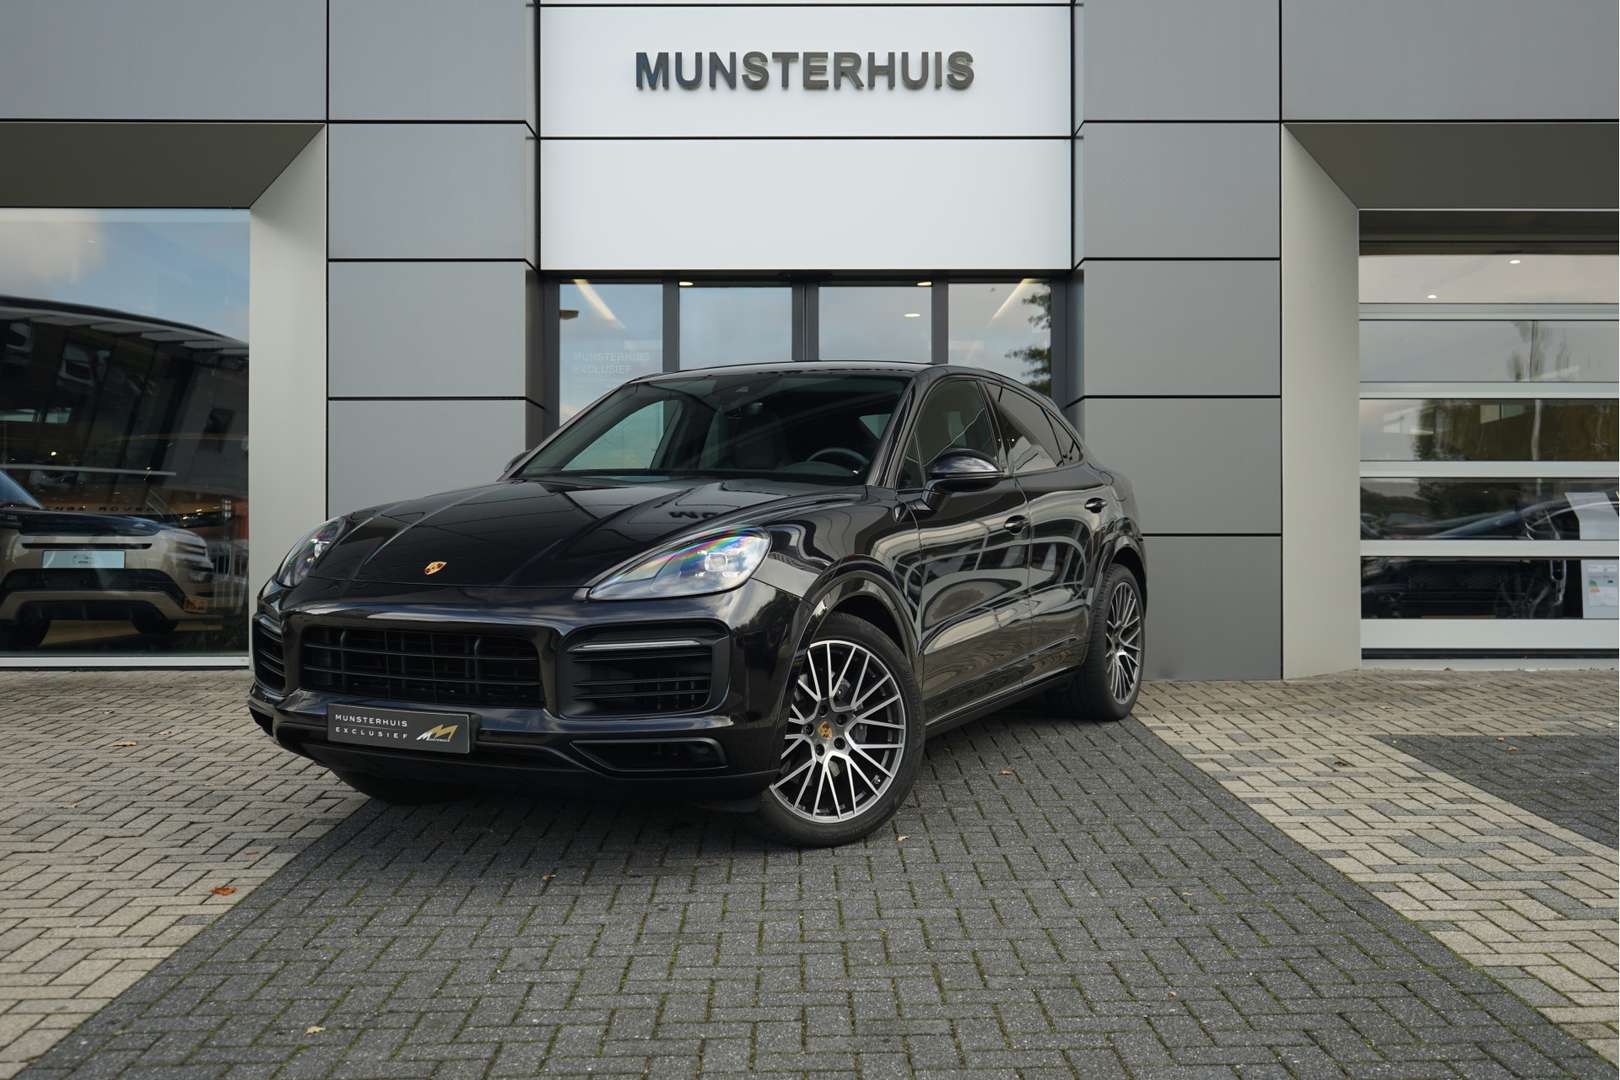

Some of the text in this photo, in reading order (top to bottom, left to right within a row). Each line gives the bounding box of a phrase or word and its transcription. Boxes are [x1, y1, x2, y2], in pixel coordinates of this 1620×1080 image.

[636, 51, 975, 91] MUNSTERHUIS
[335, 714, 408, 728] MUNSTERHUIS
[335, 726, 408, 739] EXCLUSIEF
